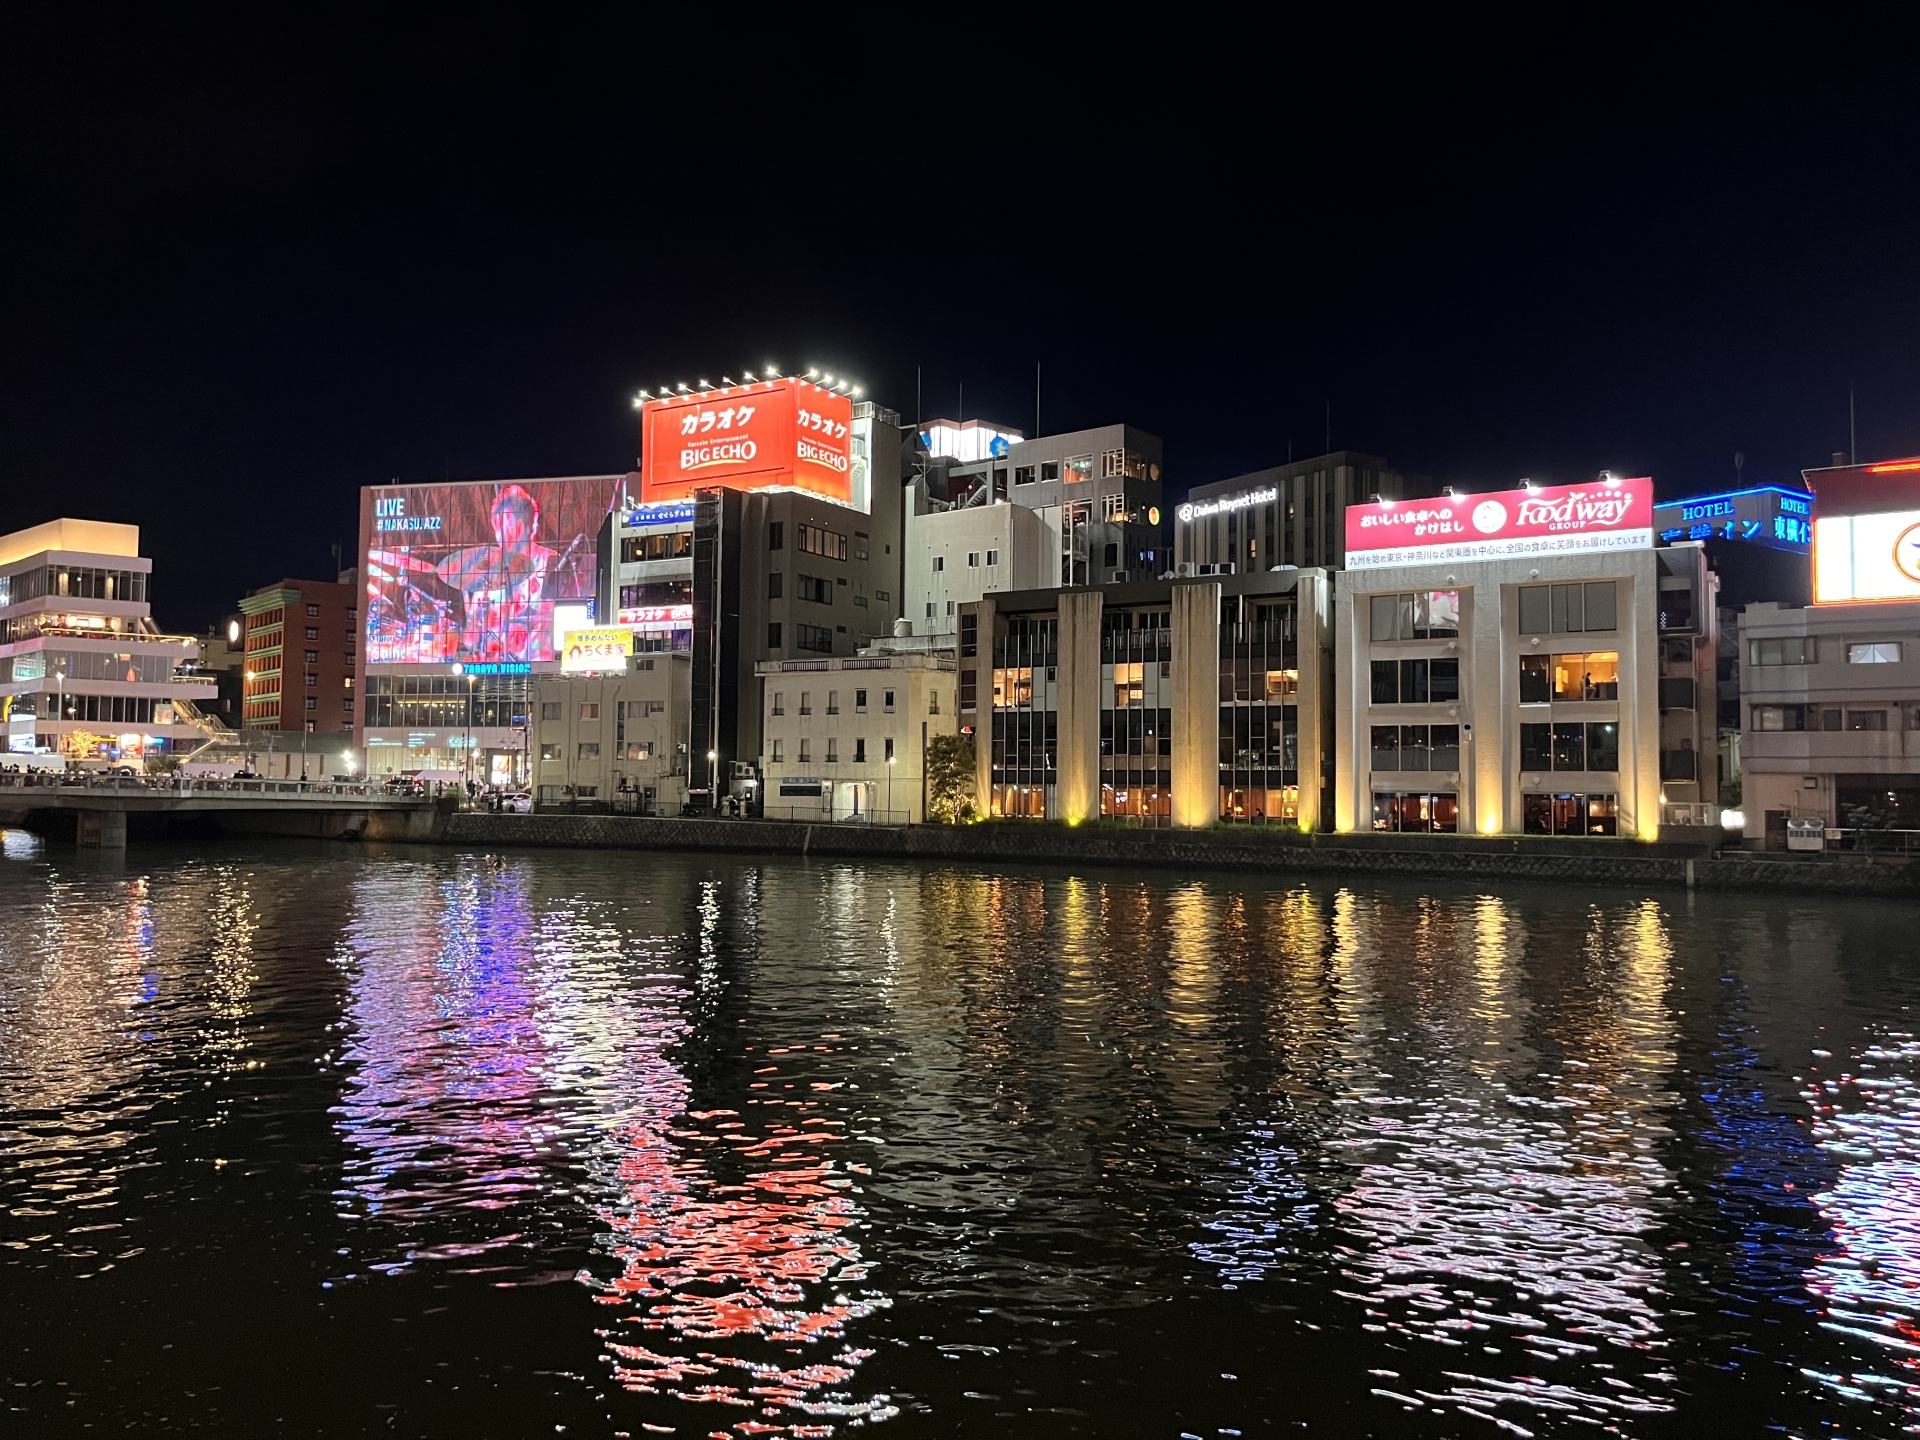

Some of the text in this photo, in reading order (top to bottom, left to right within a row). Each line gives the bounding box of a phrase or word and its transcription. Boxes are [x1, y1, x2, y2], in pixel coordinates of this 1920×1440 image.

[681, 405, 756, 436] カラオケ
[797, 408, 847, 439] カラオケ
[680, 440, 757, 470] BIG ECHO
[797, 440, 848, 472] BIG ECHO
[376, 498, 405, 517] LIVE
[1193, 487, 1277, 518] Daiwa Roynet Hotel
[1515, 492, 1634, 526] Foodway
[1682, 501, 1734, 521] HOTEL
[1780, 497, 1809, 515] HOTEL
[1360, 508, 1453, 528] おいしい食卓への
[1414, 520, 1465, 536] かけはし
[1548, 520, 1587, 531] GROUP
[627, 609, 666, 623] カラオケ
[577, 634, 618, 642] 博多めんたい
[584, 643, 626, 657] ちくま家
